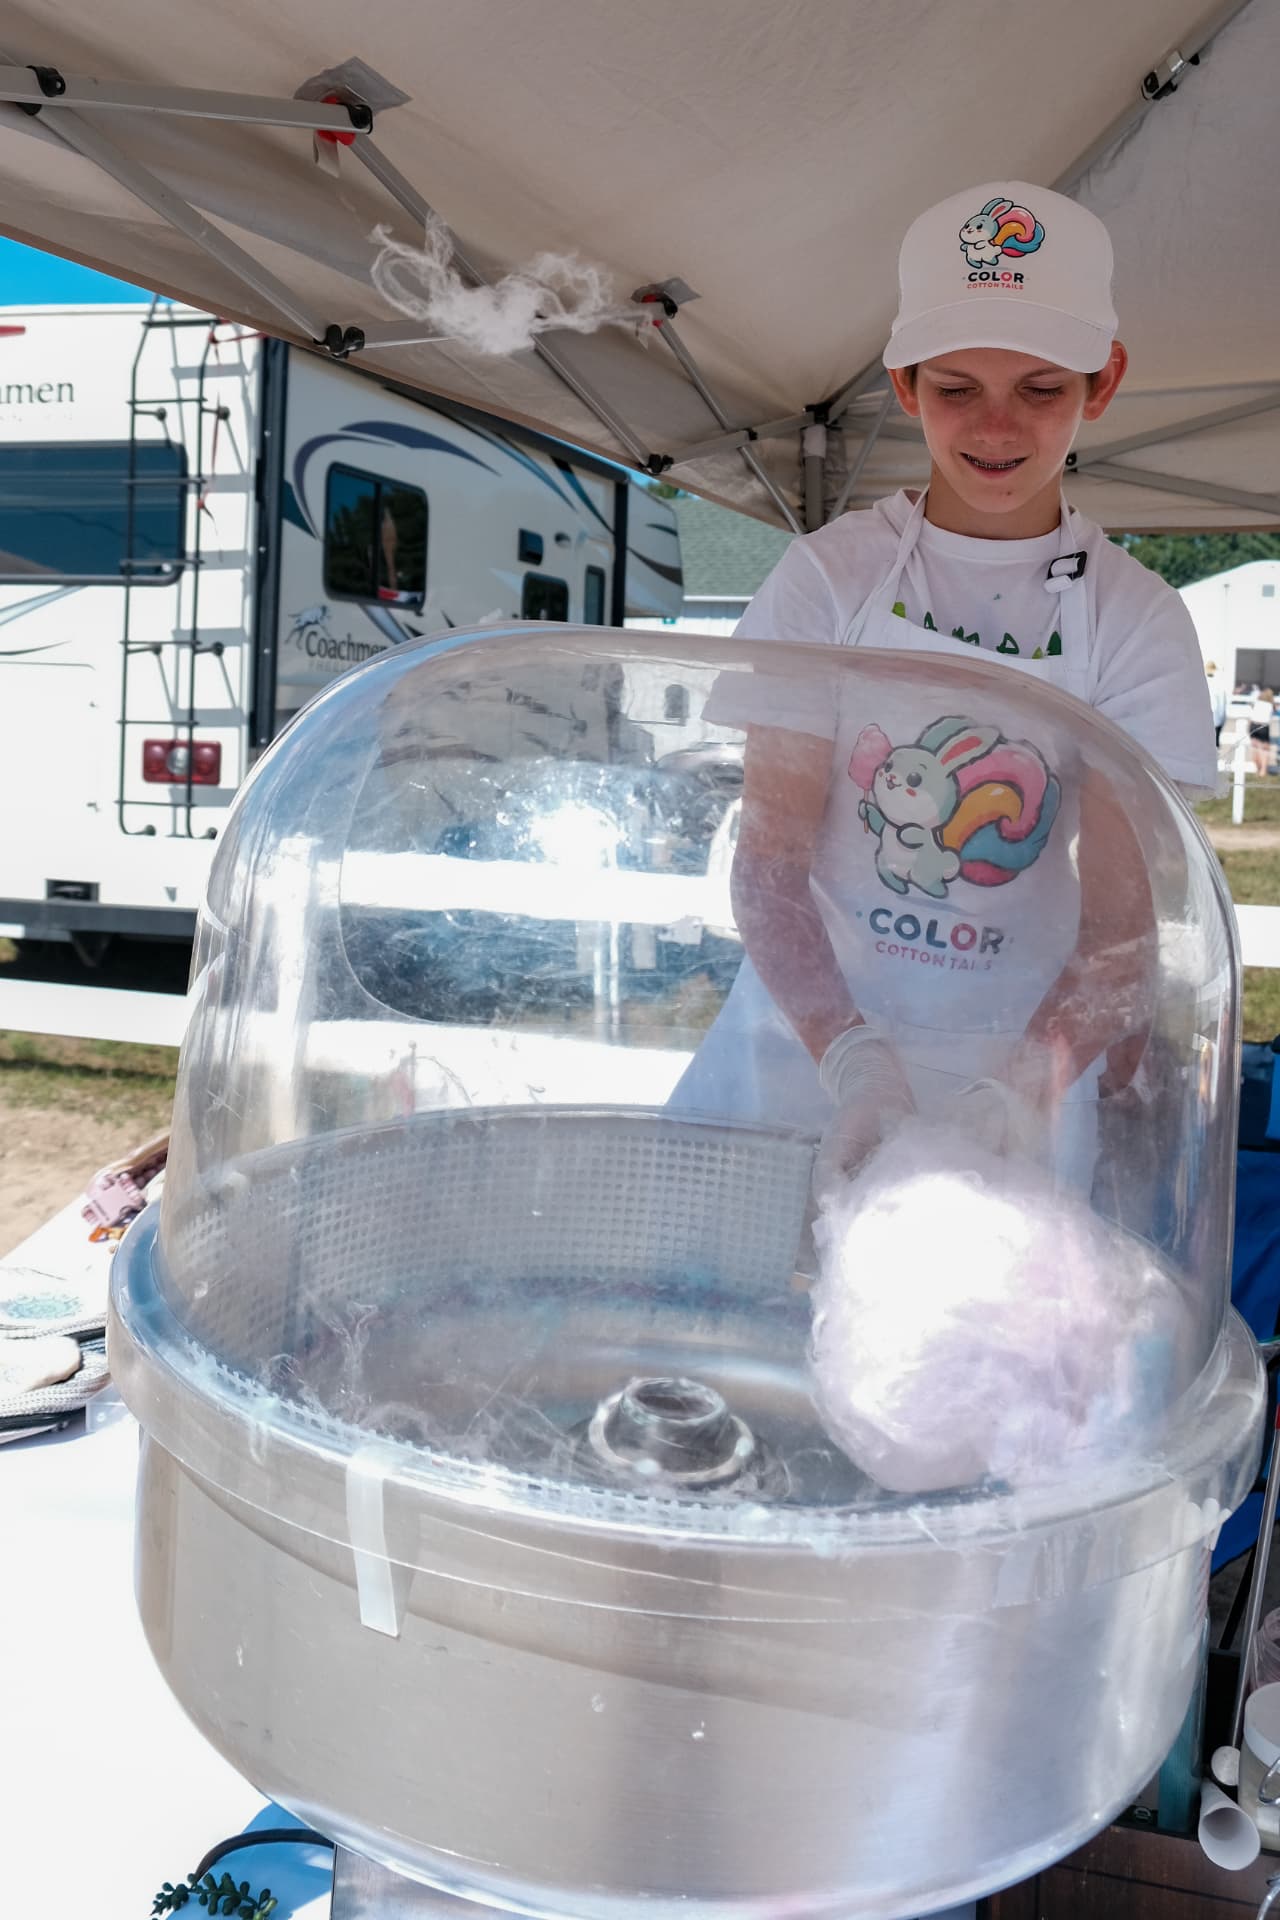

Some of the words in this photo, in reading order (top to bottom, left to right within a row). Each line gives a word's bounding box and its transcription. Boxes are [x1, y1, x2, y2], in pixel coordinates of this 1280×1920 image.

[968, 271, 1024, 283] COLOR
[1001, 282, 1024, 290] TAILS
[0, 382, 75, 404] men
[869, 908, 1004, 954] COLOR
[875, 940, 945, 968] COTTON
[950, 957, 993, 972] TAIS
